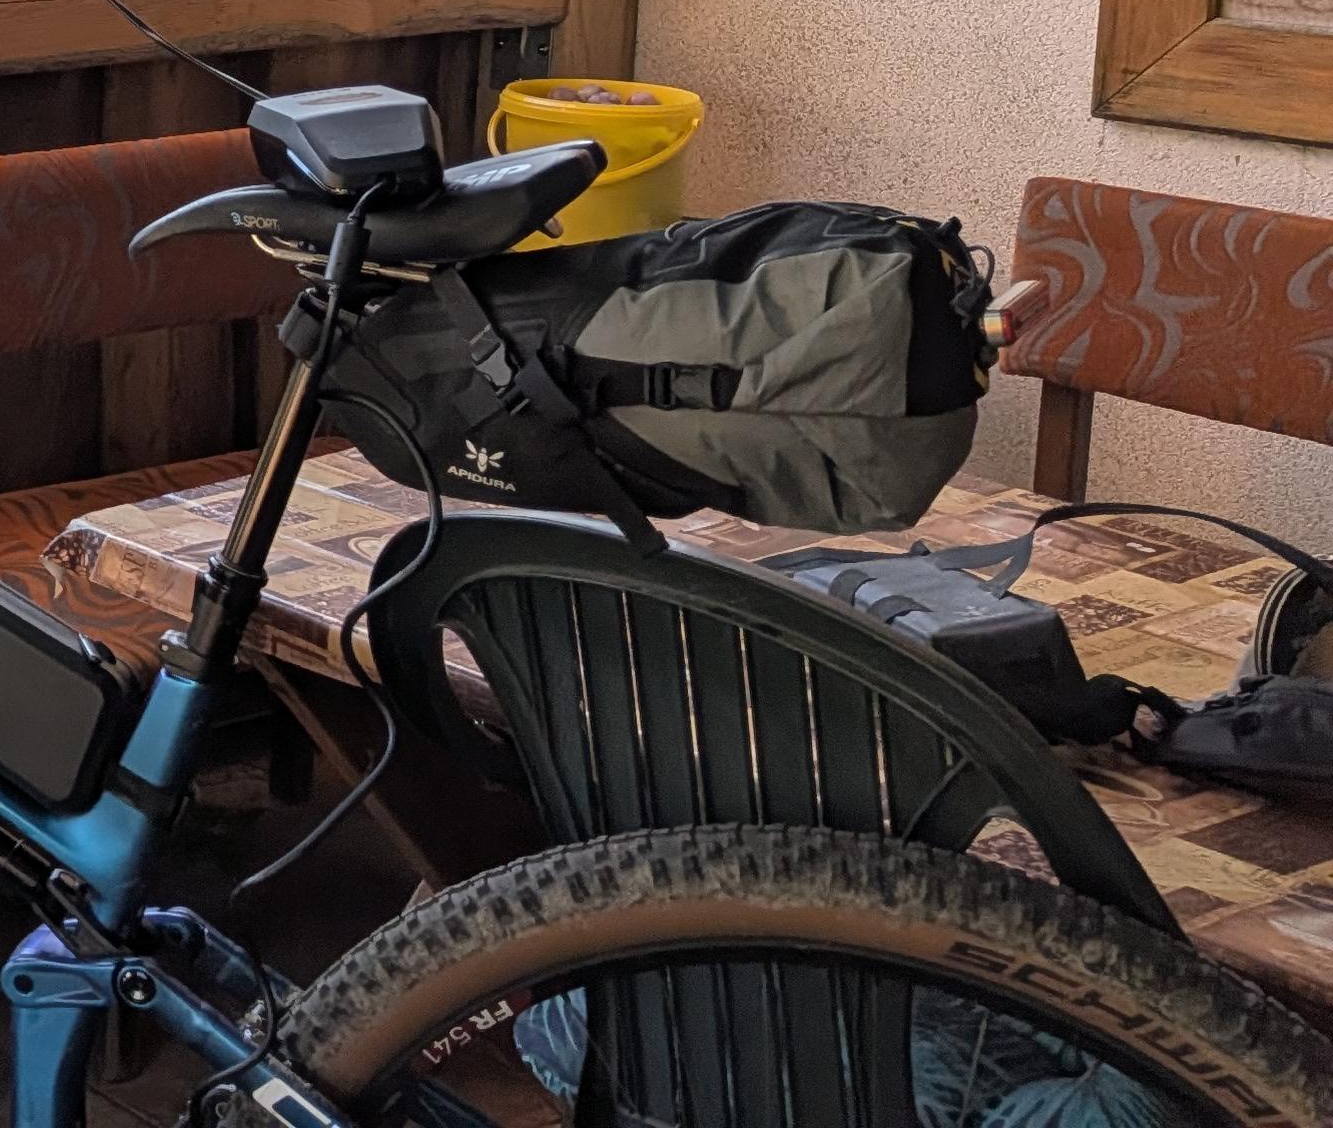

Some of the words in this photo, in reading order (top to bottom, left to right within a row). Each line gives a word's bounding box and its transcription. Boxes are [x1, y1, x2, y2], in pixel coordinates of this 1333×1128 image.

[447, 465, 516, 492] APIDURA
[469, 1000, 514, 1030] FR
[422, 1026, 471, 1064] 541
